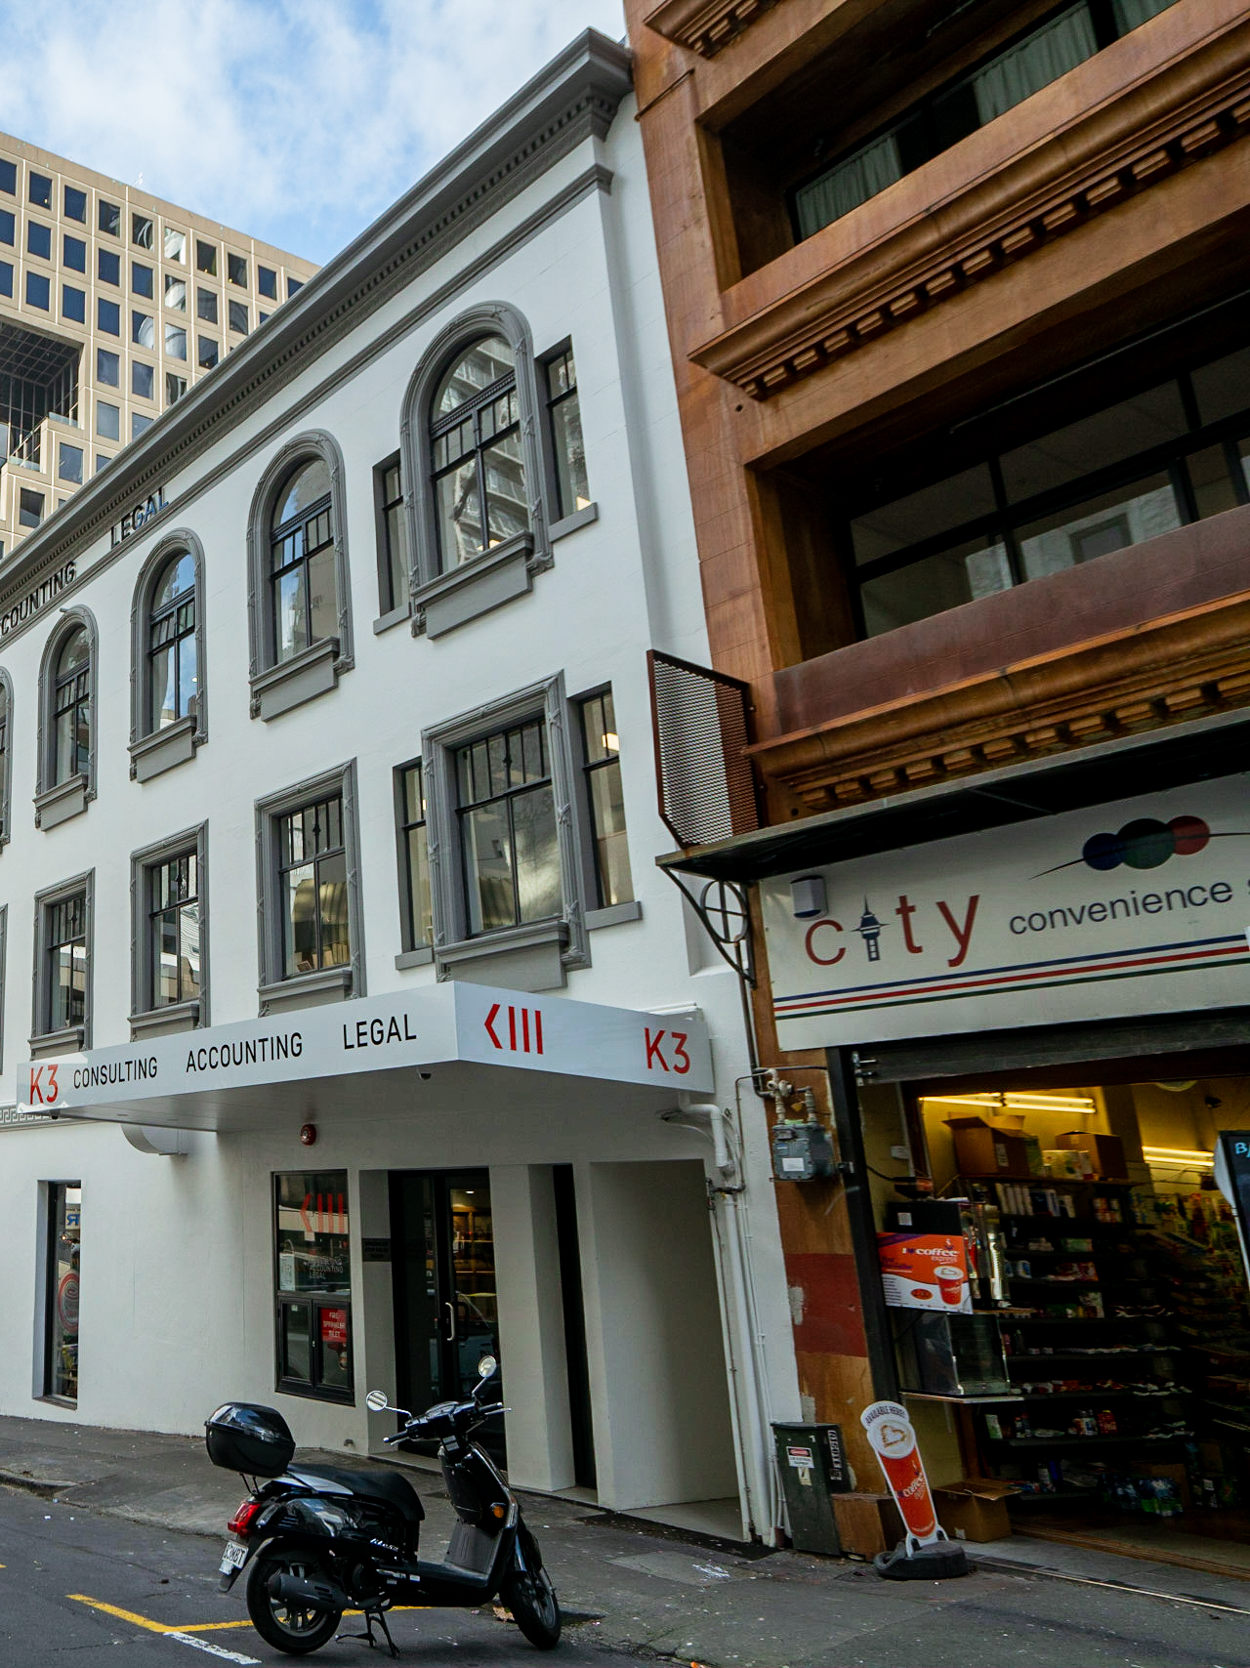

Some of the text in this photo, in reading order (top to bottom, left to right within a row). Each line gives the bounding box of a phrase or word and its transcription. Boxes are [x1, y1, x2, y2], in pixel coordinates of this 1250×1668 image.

[110, 487, 169, 549] LEGAL
[1009, 881, 1233, 935] convenience
[29, 1013, 417, 1105] K3 CONSULTING ACCOUNTING LEGAL
[644, 1027, 691, 1074] K3
[916, 1247, 959, 1257] coffee
